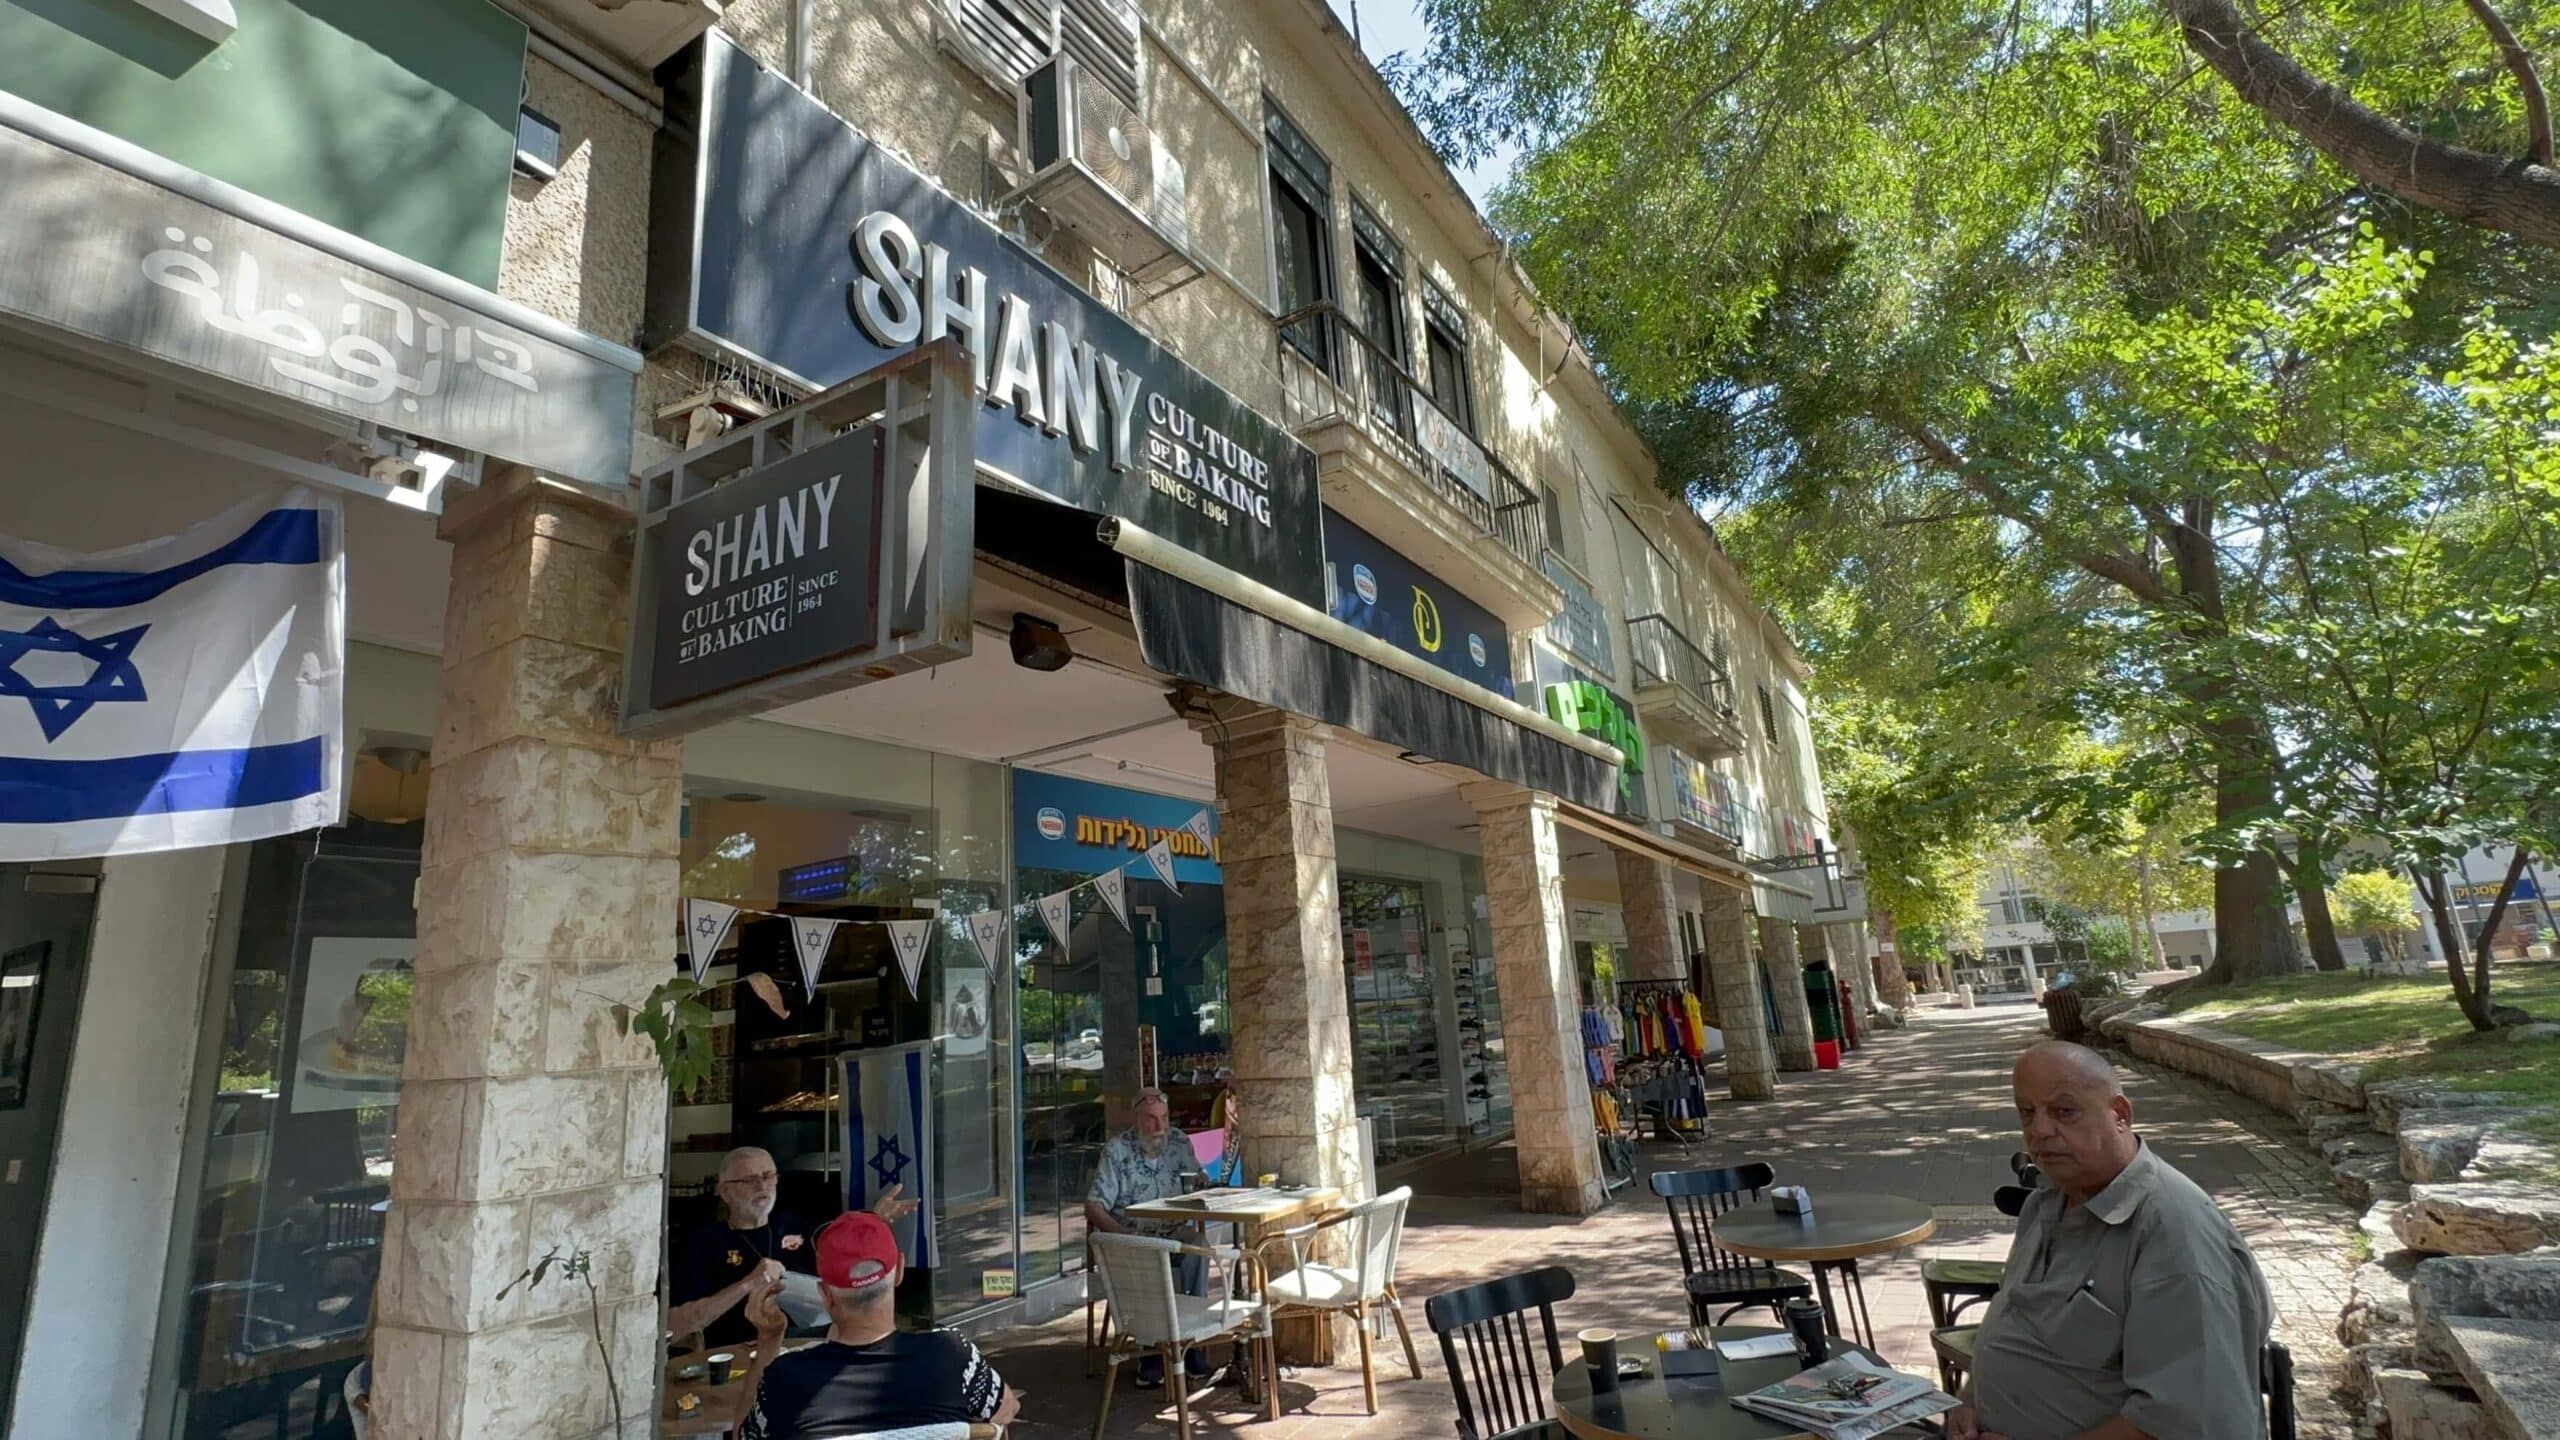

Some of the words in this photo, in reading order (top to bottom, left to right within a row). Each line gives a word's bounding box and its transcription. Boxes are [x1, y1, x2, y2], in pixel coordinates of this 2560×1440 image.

[142, 226, 442, 412] بوظة
[853, 210, 1142, 472] SHANY
[1147, 391, 1268, 490] CULTURE
[1150, 438, 1170, 460] OF
[1173, 444, 1272, 528] BAKING
[1150, 468, 1197, 509] SINCE
[1202, 498, 1229, 526] 1964
[685, 473, 842, 597] SHANY
[681, 576, 788, 634] CULTURE
[797, 570, 839, 596] SINCE
[797, 594, 822, 614] 1964
[680, 642, 696, 660] OF
[698, 606, 787, 658] BAKING
[1077, 816, 1148, 850] גלידות
[851, 1274, 881, 1288] CANADA
